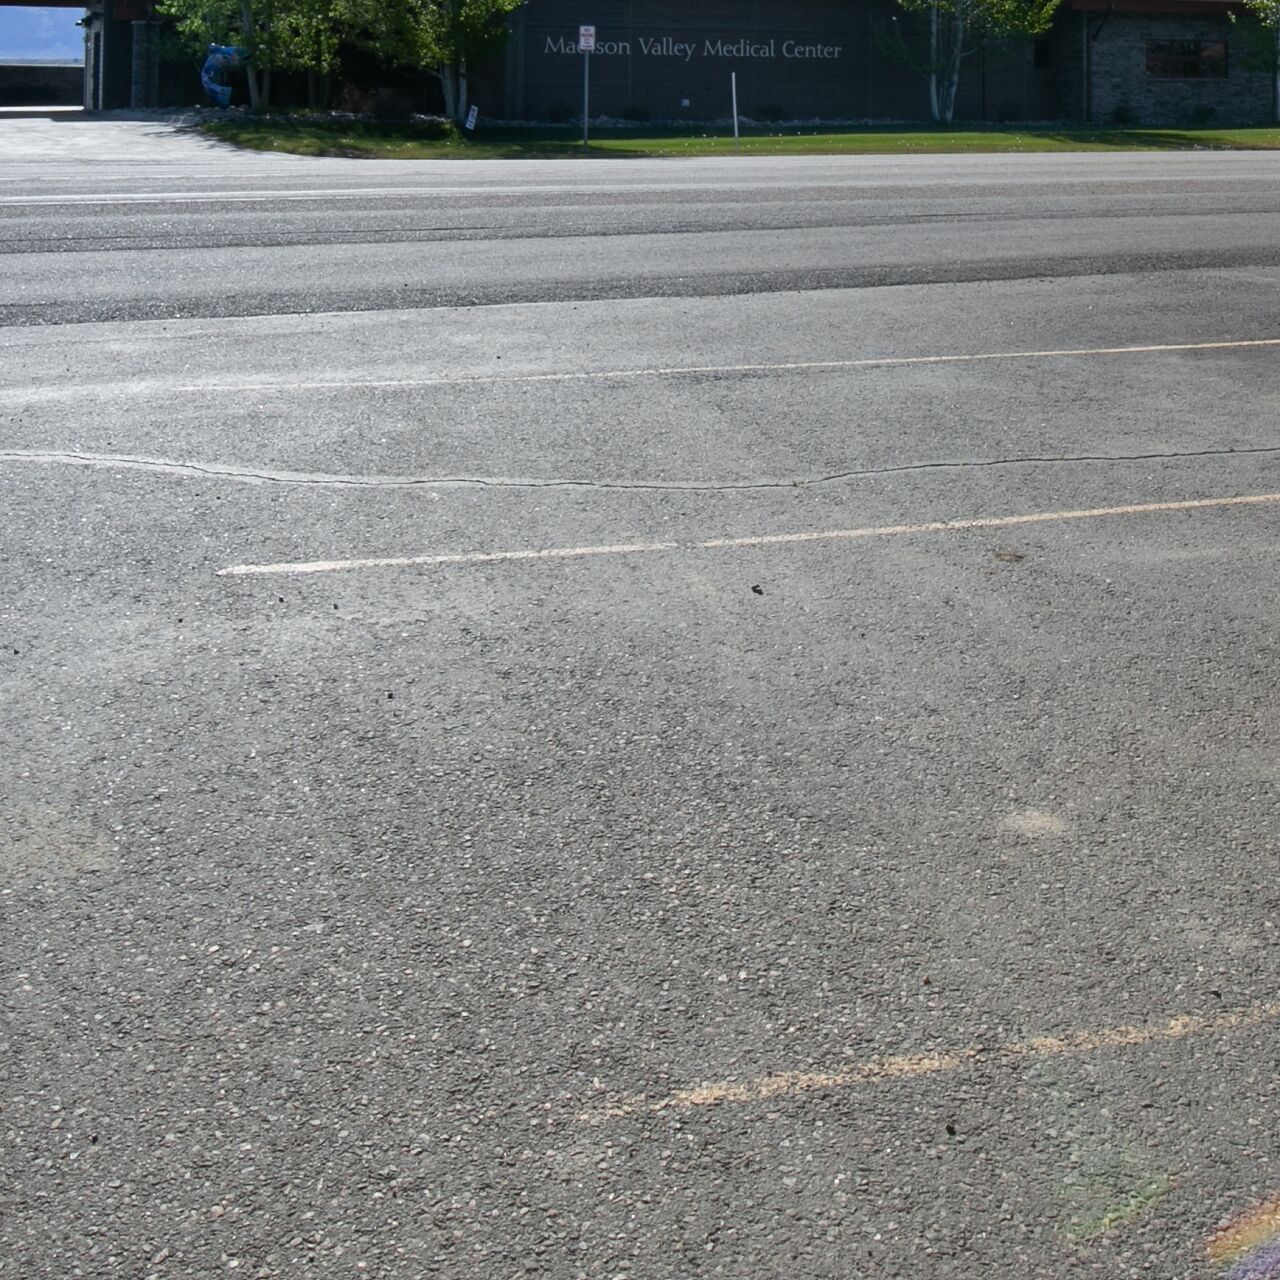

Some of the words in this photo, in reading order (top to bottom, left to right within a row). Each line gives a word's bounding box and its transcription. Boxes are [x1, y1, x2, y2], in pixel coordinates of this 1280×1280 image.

[544, 36, 631, 55] Mason
[638, 37, 696, 62] Valley
[703, 39, 775, 58] Medical
[782, 40, 842, 59] Center
